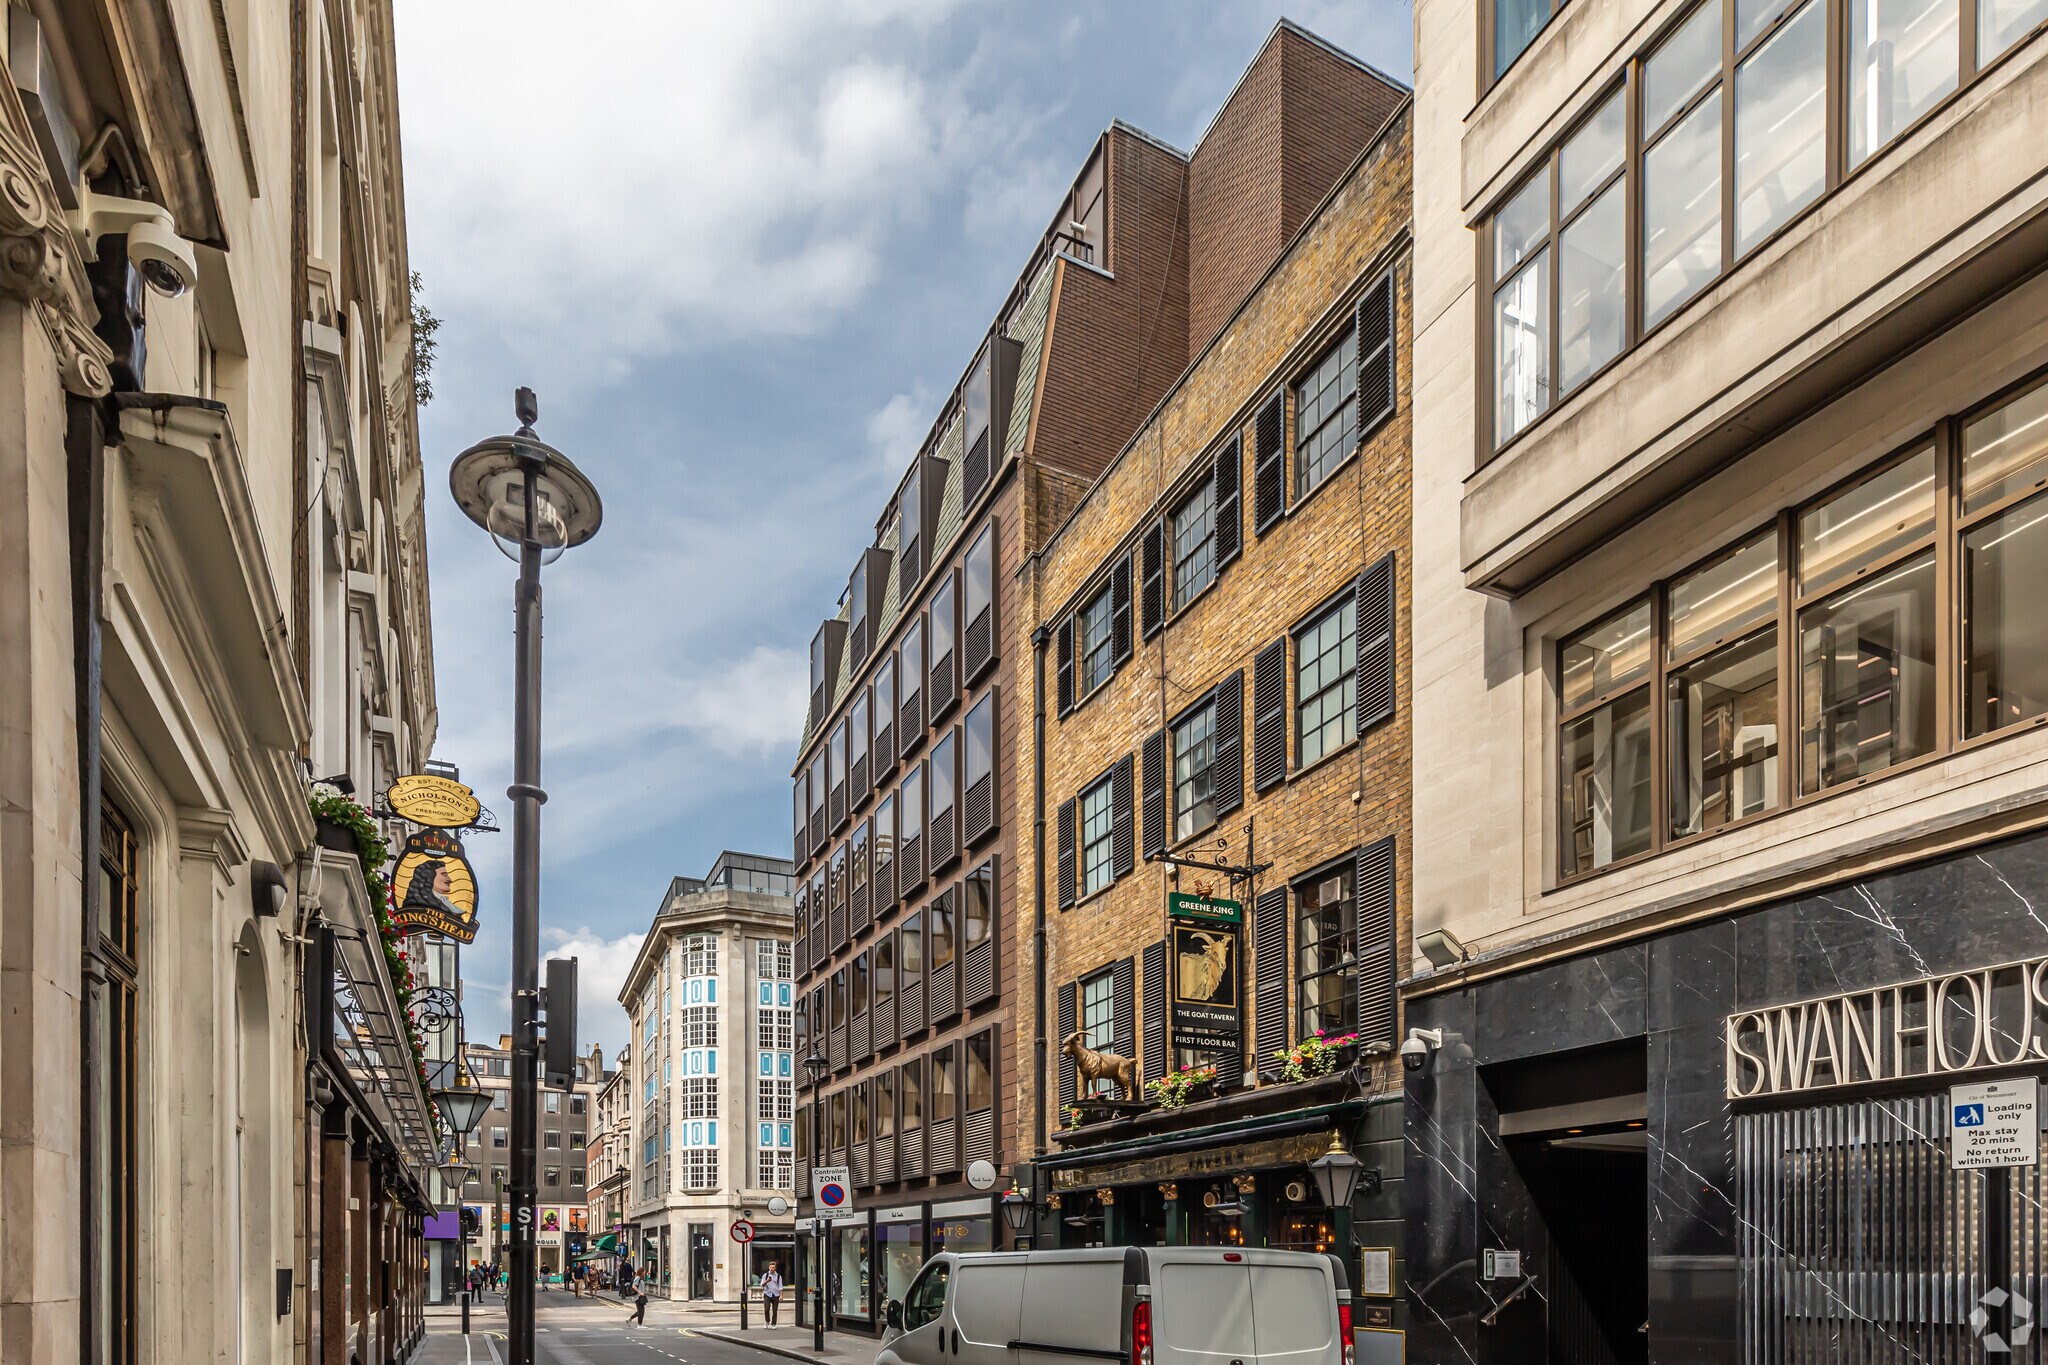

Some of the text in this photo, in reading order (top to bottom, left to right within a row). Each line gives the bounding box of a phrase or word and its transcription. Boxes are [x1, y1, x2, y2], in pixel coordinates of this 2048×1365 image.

[435, 780, 452, 788] 1873
[400, 792, 470, 812] NICHOLSON'S
[415, 808, 454, 817] FREEHOUSE
[426, 907, 445, 919] THE
[1179, 901, 1211, 912] GREENE
[1213, 905, 1234, 915] KING
[439, 920, 474, 940] HEAD
[1177, 1009, 1235, 1021] THE GOAT TAVERN
[1175, 1036, 1236, 1048] FIRST FLOOR BAR
[1731, 992, 1881, 1097] SWAN
[1988, 1102, 2032, 1112] Loading
[1997, 1112, 2022, 1120] only
[1995, 1127, 2019, 1135] stay
[1989, 1136, 2016, 1144] mins
[1966, 1147, 2021, 1157] No return
[1957, 1157, 1991, 1165] within
[2004, 1155, 2030, 1163] hour
[518, 1207, 531, 1223] S
[520, 1225, 527, 1240] 1
